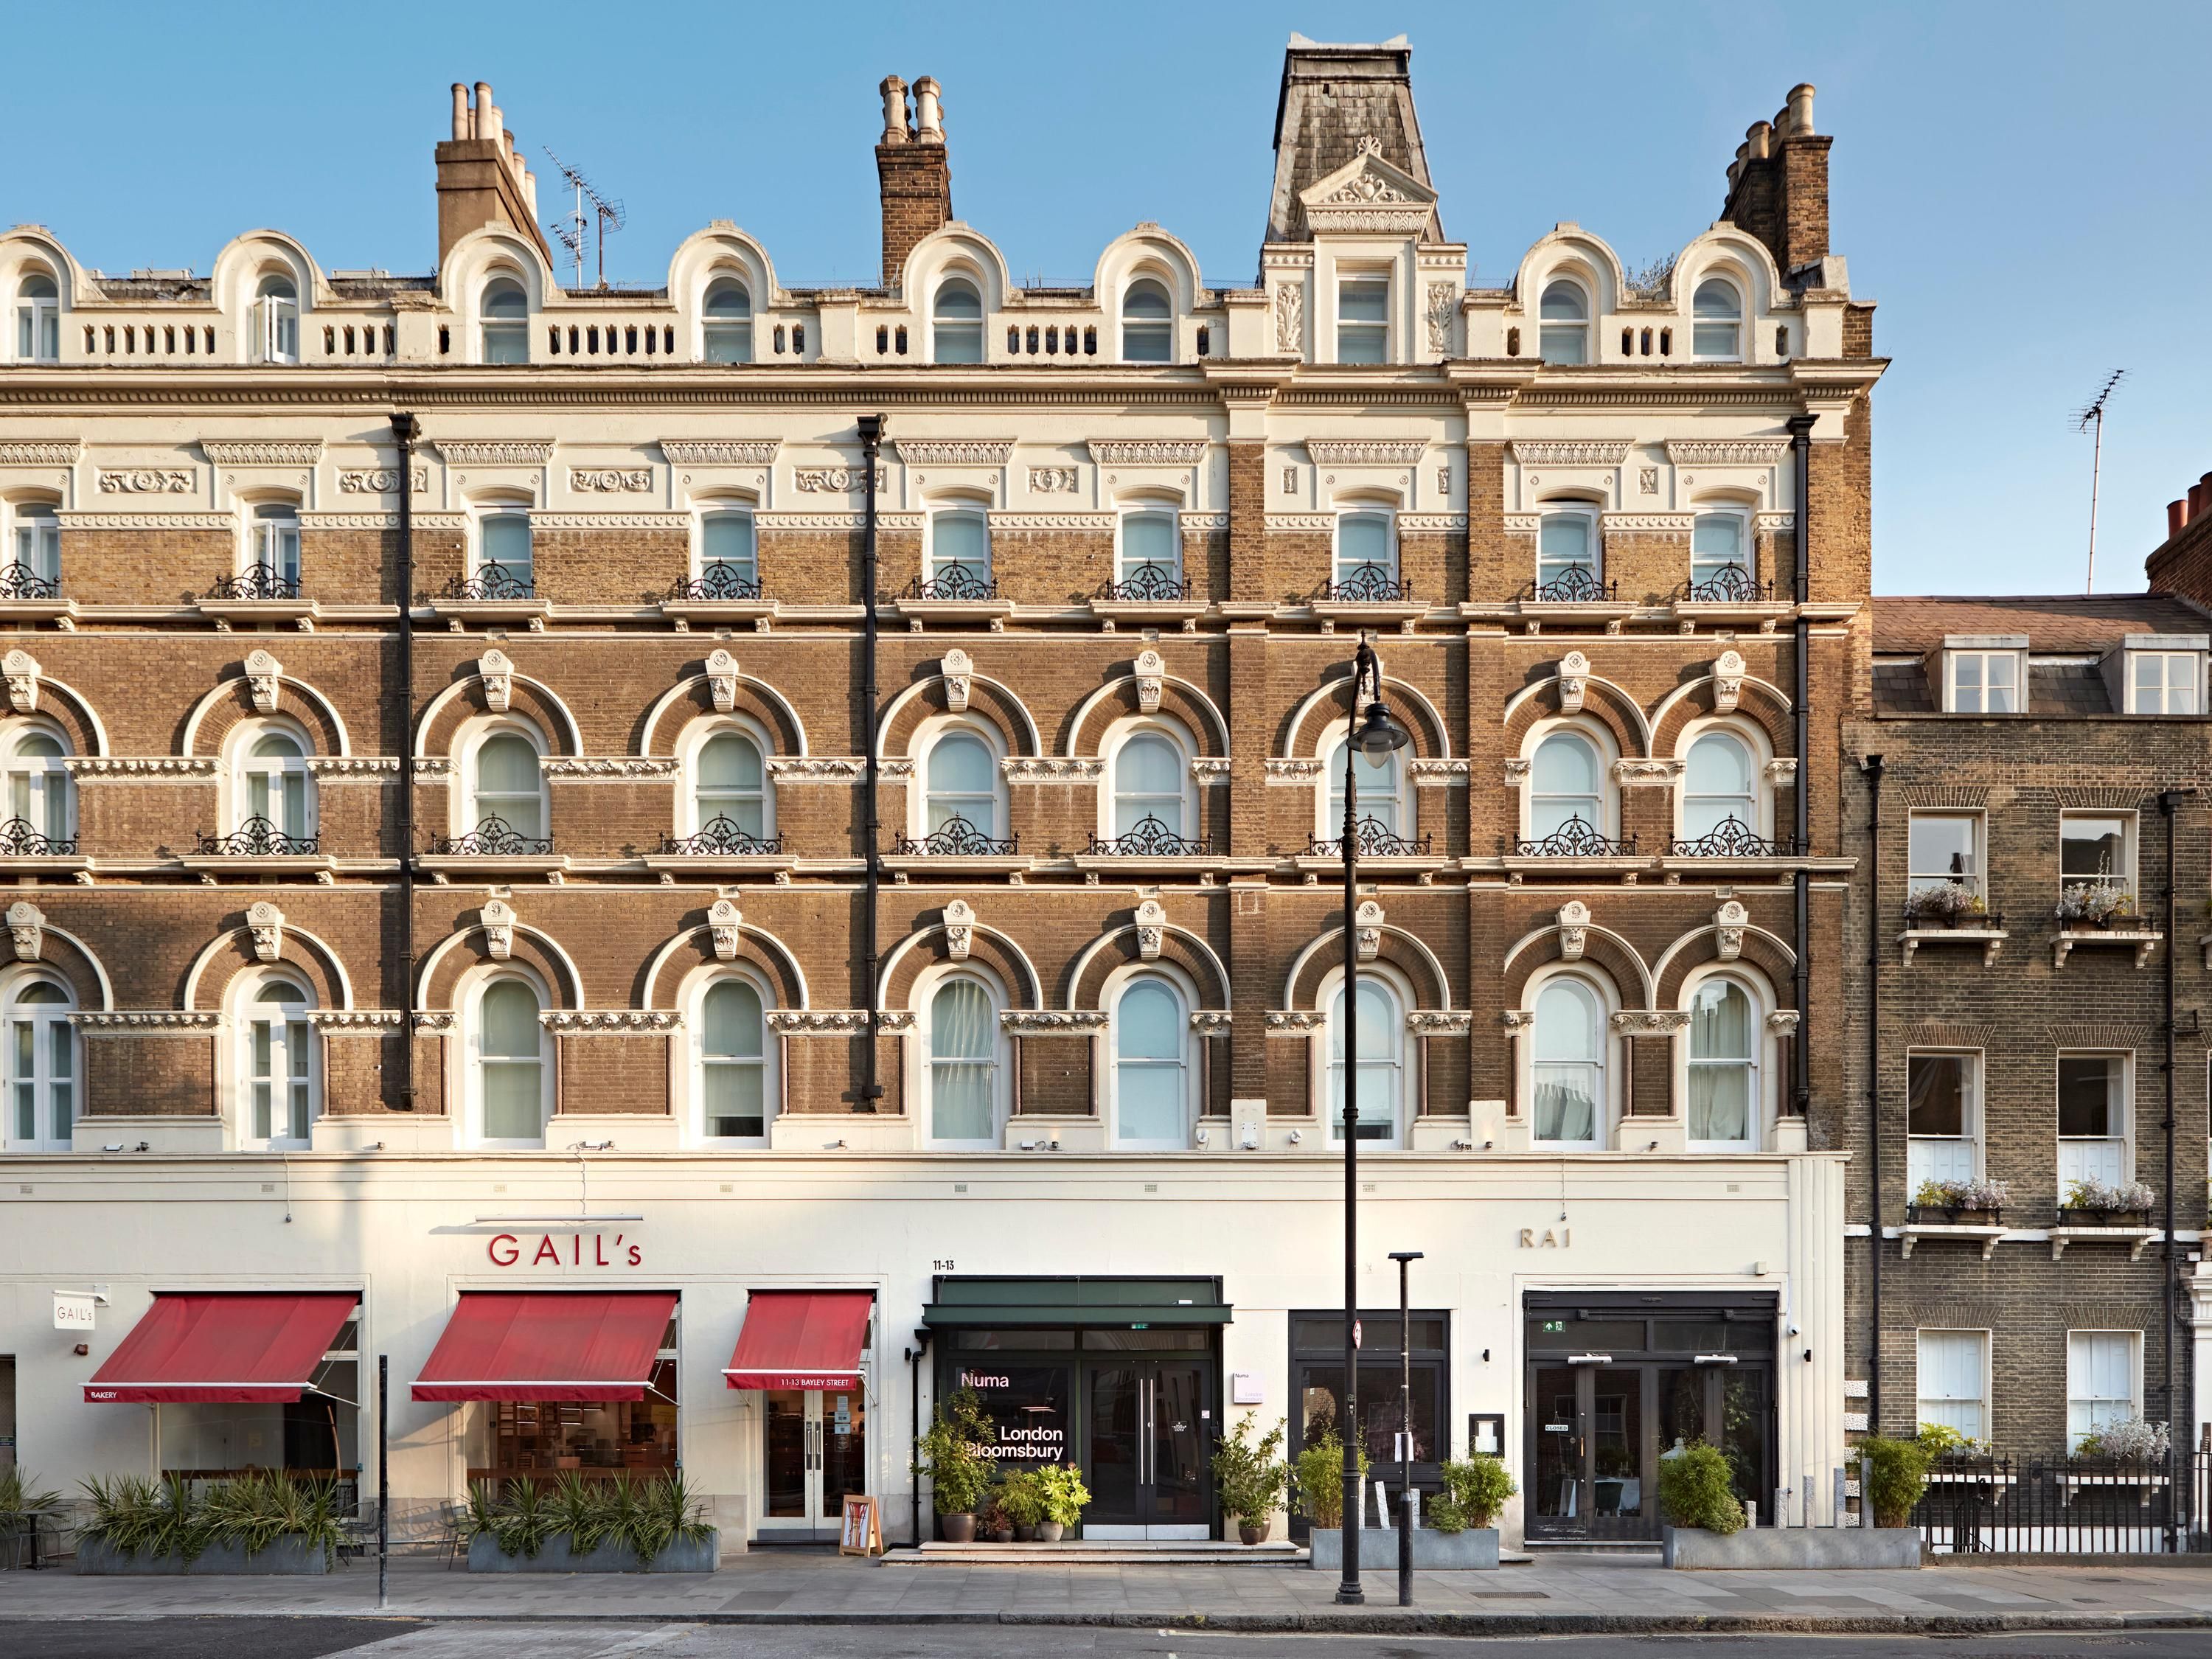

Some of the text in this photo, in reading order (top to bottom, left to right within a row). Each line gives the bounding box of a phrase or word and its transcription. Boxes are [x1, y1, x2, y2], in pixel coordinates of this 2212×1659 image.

[1520, 1228, 1570, 1248] RAI
[933, 1260, 954, 1270] 11-13
[961, 1372, 1009, 1387] Numa
[1001, 1426, 1062, 1441] London
